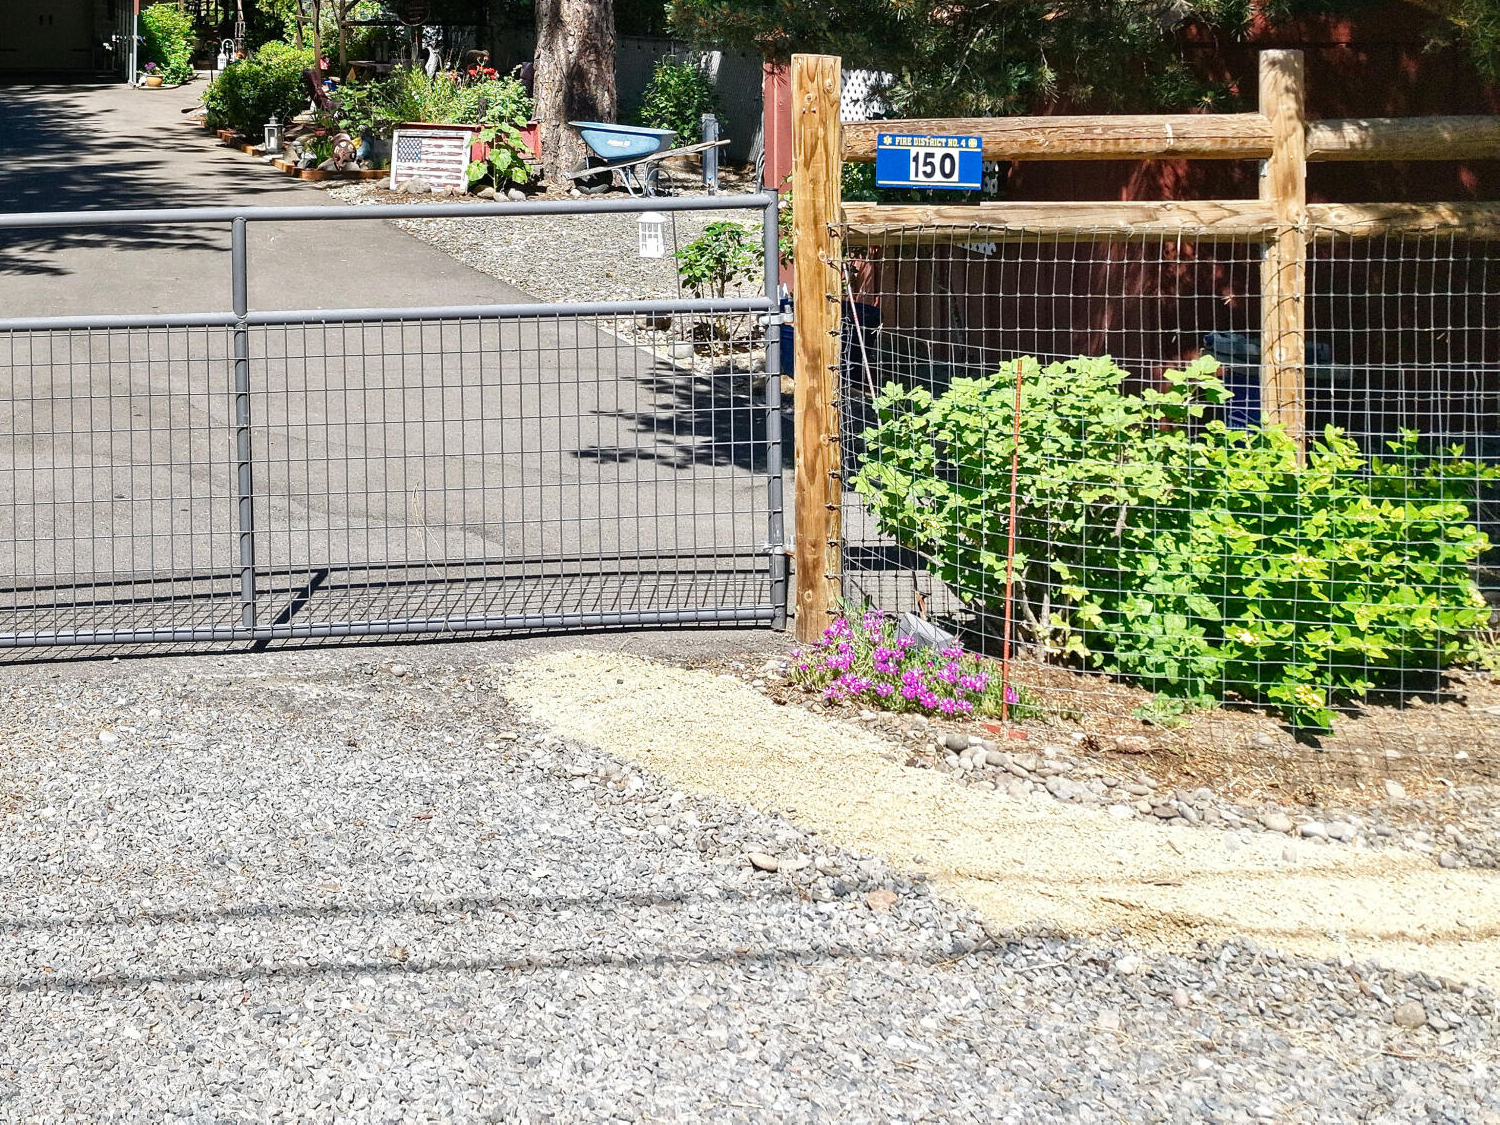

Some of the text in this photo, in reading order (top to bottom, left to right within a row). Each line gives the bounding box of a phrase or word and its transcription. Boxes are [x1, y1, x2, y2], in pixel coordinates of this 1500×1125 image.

[895, 136, 966, 148] FIRE DISTRICT NO. 4
[912, 151, 956, 179] 150
